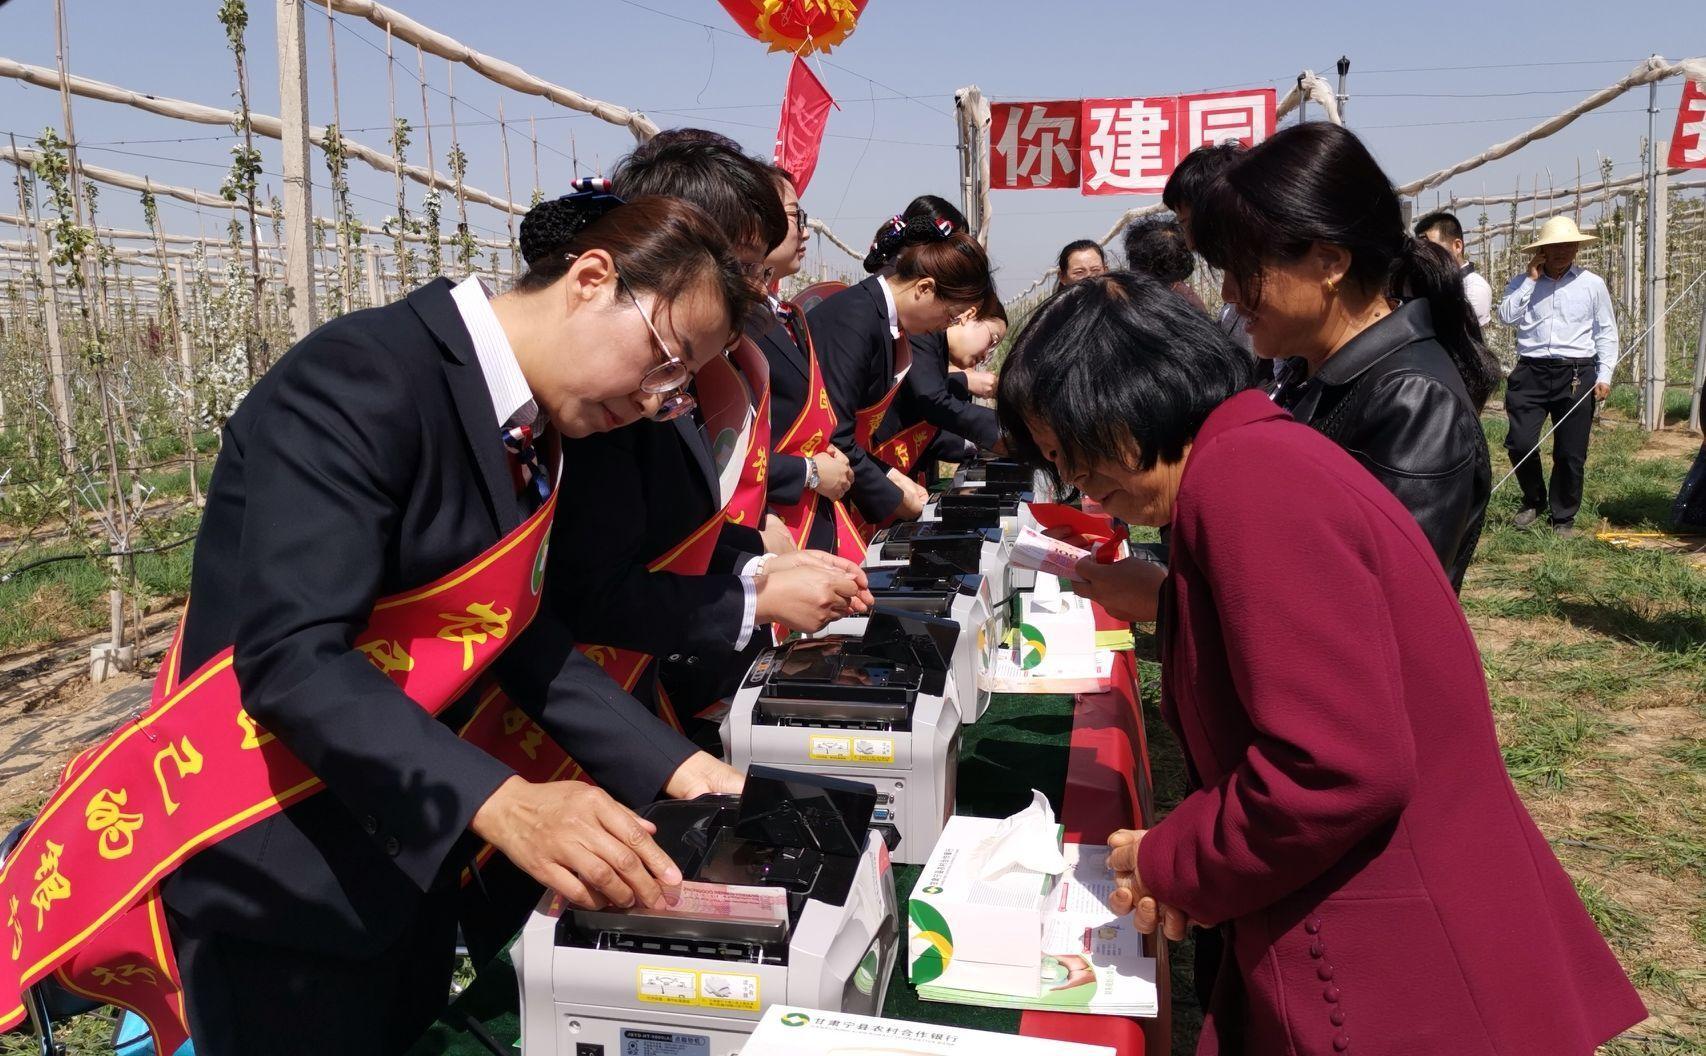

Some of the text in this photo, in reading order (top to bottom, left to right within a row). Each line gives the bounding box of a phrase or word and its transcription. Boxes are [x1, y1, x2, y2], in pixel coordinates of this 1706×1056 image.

[815, 1017, 958, 1043] 甘肃宁县农村合作银行
